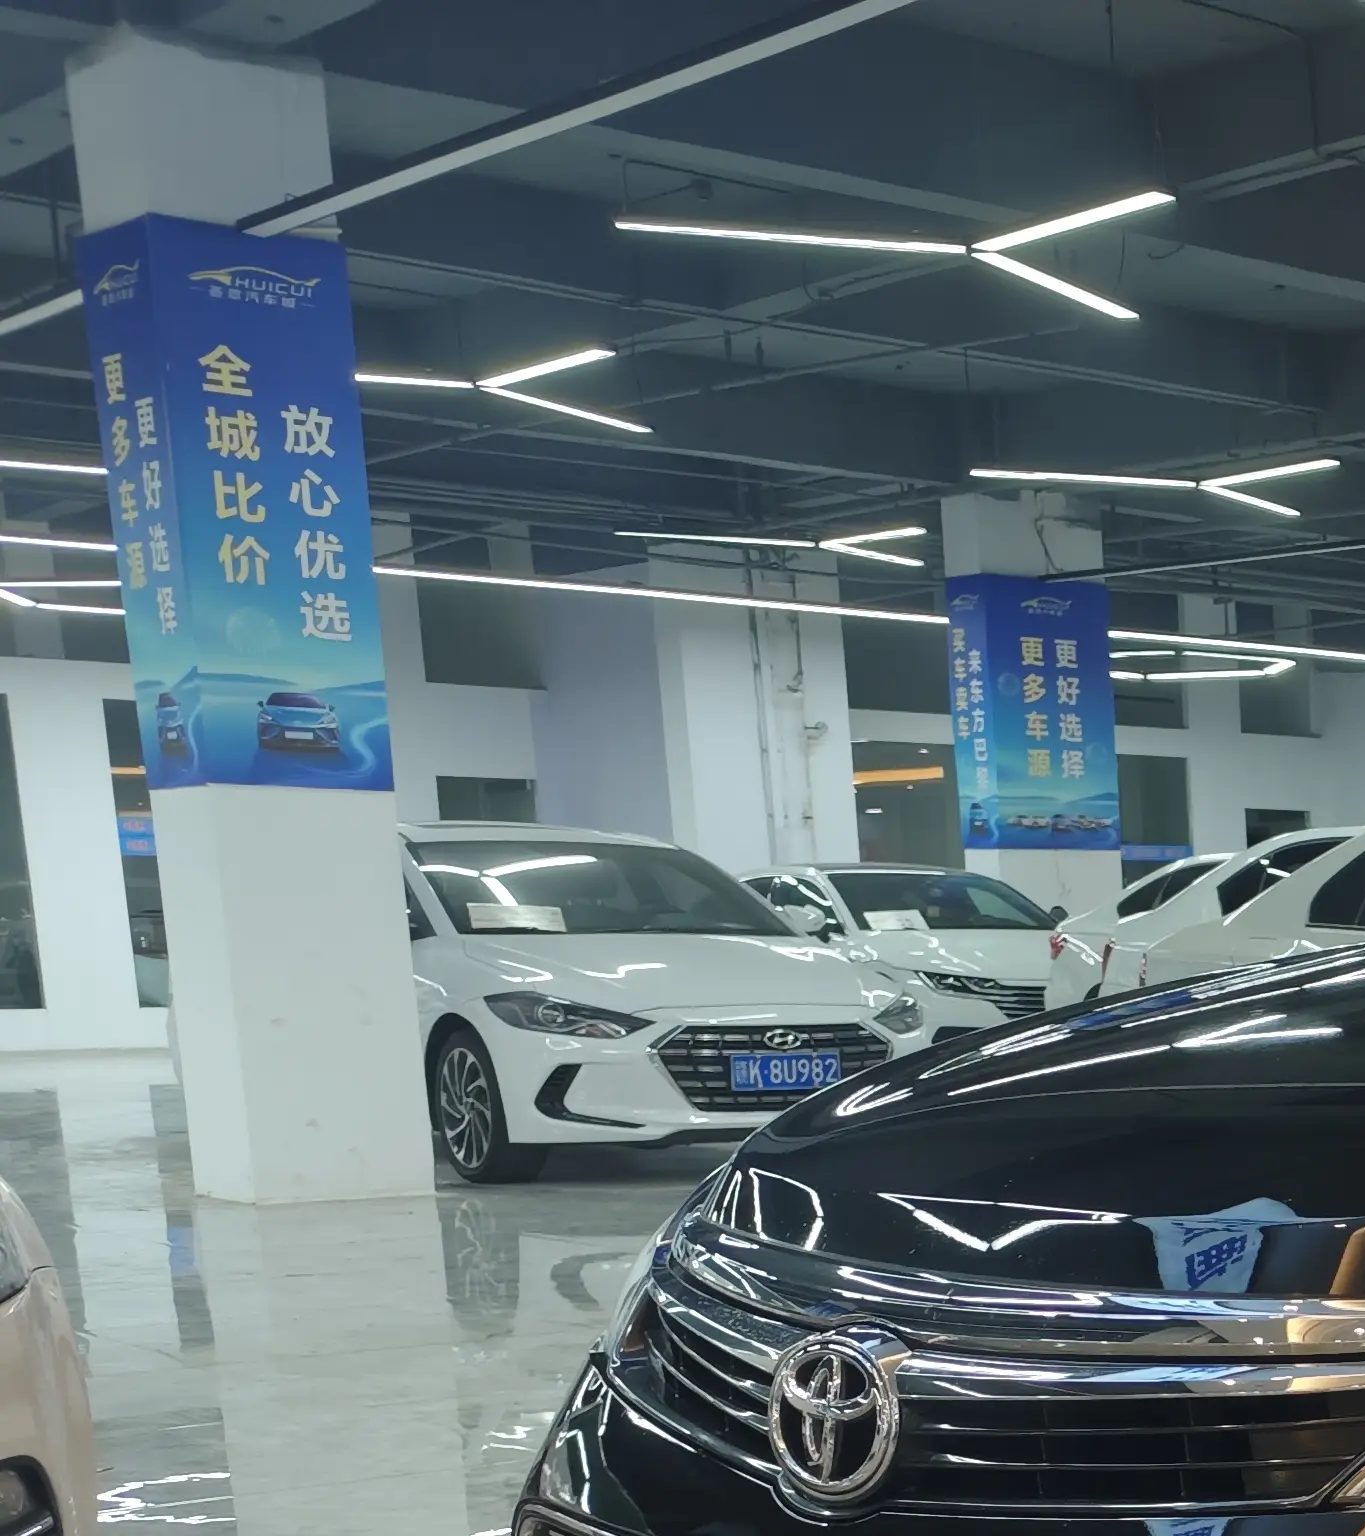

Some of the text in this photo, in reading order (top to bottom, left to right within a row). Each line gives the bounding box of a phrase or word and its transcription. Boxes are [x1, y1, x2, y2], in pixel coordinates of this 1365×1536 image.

[234, 277, 312, 298] HUICUI
[102, 352, 148, 590] 更多车源
[134, 396, 178, 636] 更好选择
[197, 343, 271, 587] 全城比价
[279, 404, 353, 643] 放心优选
[1019, 636, 1053, 779] 更多车源
[1053, 638, 1086, 780] 更好选择
